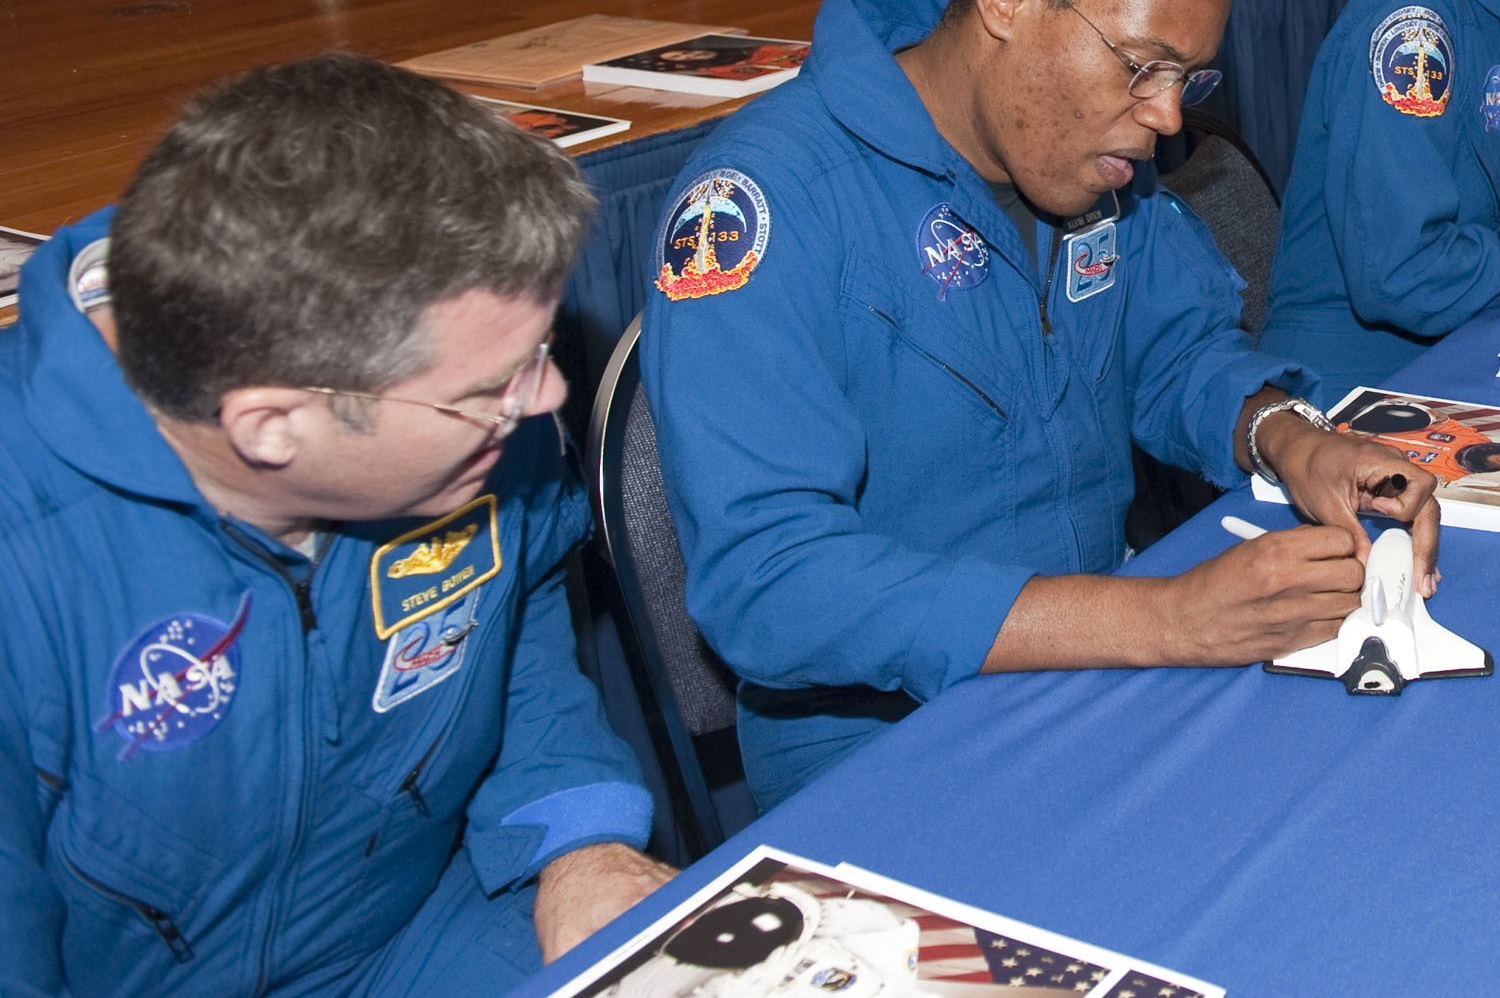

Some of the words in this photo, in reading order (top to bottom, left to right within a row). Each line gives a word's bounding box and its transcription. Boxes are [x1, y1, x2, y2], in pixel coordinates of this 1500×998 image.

[1394, 65, 1414, 76] STS
[742, 177, 767, 216] BARRATT
[674, 235, 695, 250] STS
[709, 230, 740, 243] 133
[924, 231, 984, 267] NASA
[401, 585, 438, 613] STEVE
[119, 654, 236, 717] NASA
